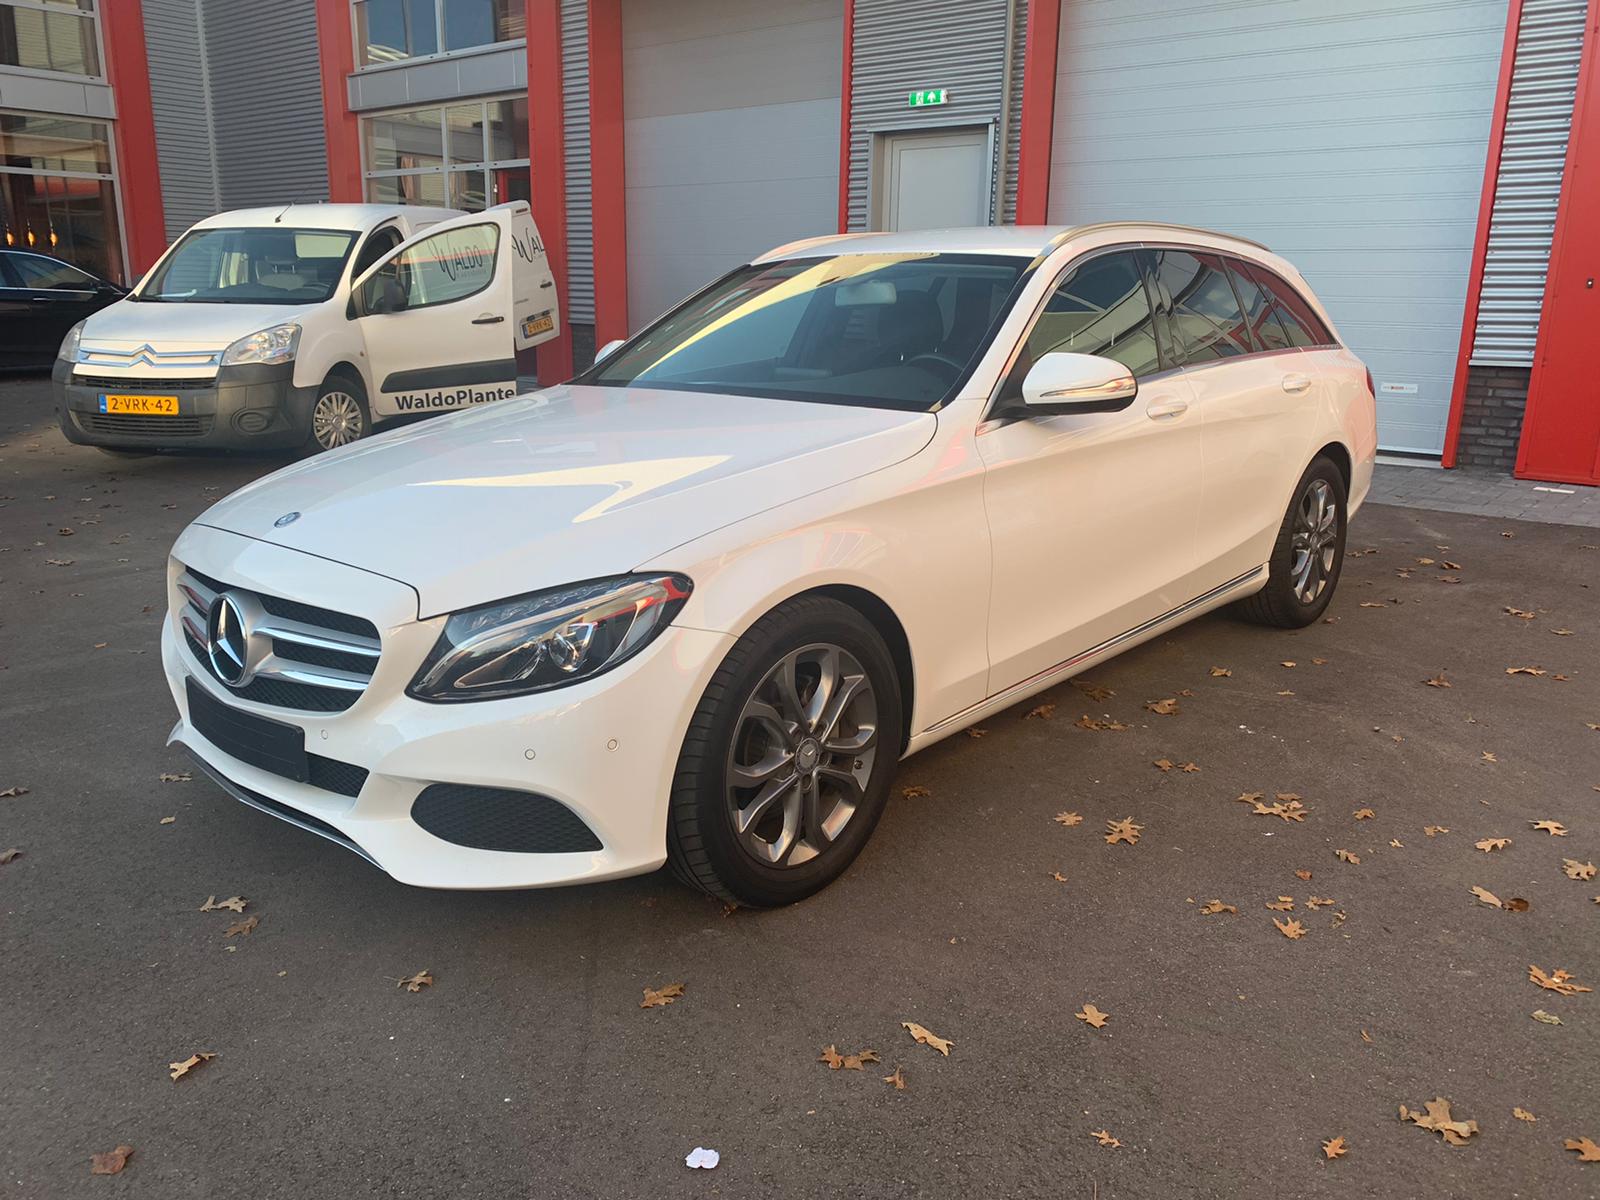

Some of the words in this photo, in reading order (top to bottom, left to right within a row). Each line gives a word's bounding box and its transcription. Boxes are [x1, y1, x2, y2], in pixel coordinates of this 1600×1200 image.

[427, 234, 483, 281] WALDO
[111, 397, 173, 412] 2-VRK-42
[395, 388, 515, 410] WaldoPlante
